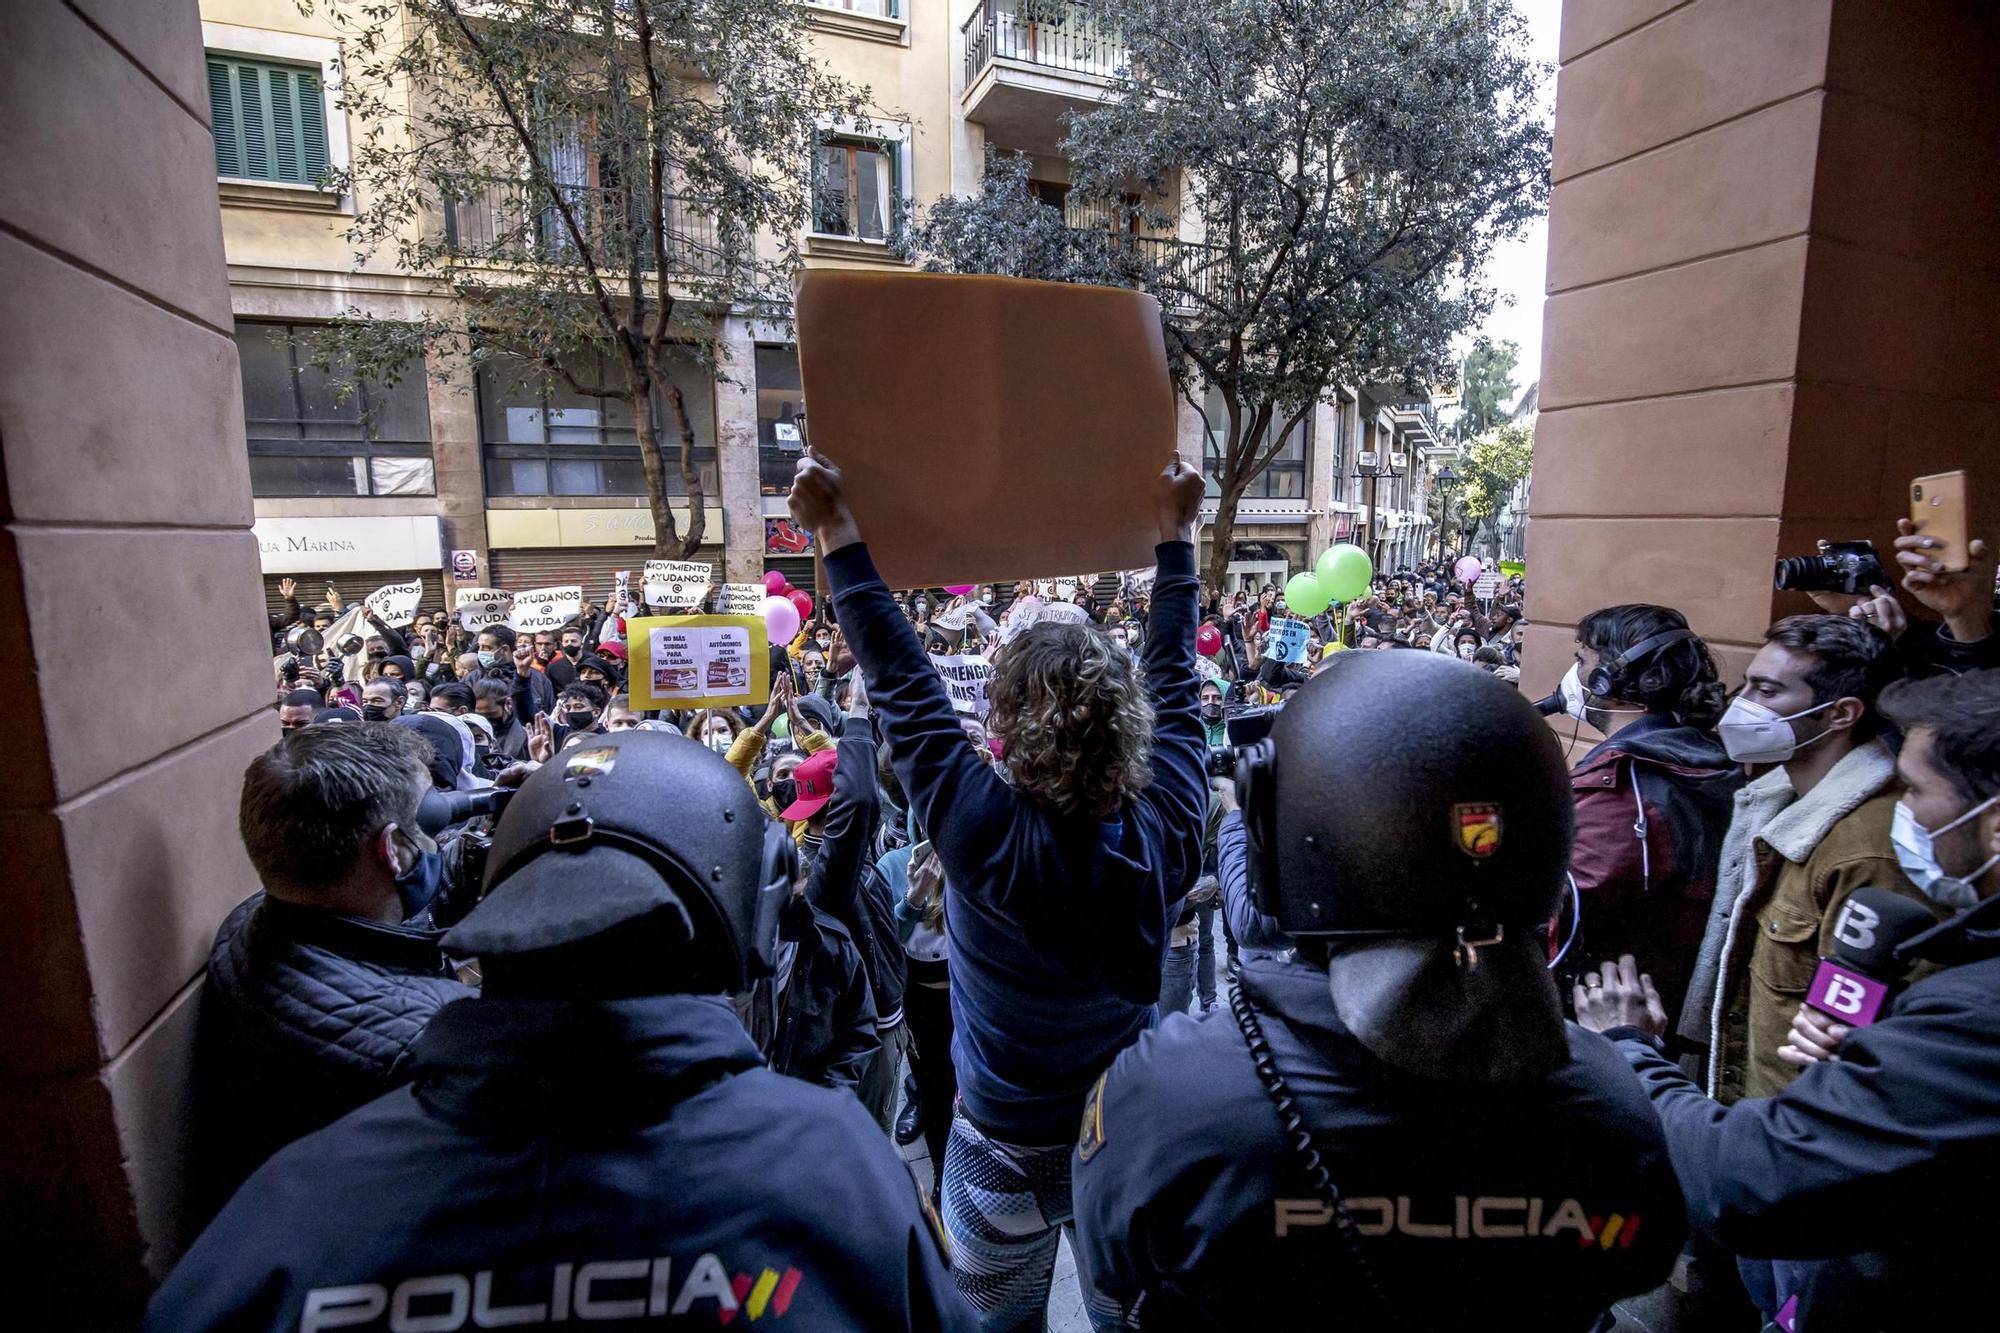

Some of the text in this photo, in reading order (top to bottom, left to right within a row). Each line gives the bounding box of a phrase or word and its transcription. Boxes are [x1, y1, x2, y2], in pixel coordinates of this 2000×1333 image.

[286, 536, 355, 552] MARINA
[646, 561, 710, 573] MOVIMIENTO
[649, 573, 705, 583] AYUDANOS
[672, 583, 683, 594] @
[367, 585, 421, 609] AYUDANOS
[518, 591, 580, 605] AYUDANOS
[656, 595, 697, 605] AYUDAR
[724, 603, 755, 611] MAYORES
[470, 613, 511, 625] AYUDA
[935, 663, 992, 682] ARMENGO
[1274, 1196, 1595, 1240] POLICIA
[301, 1252, 739, 1333] POLICIA
